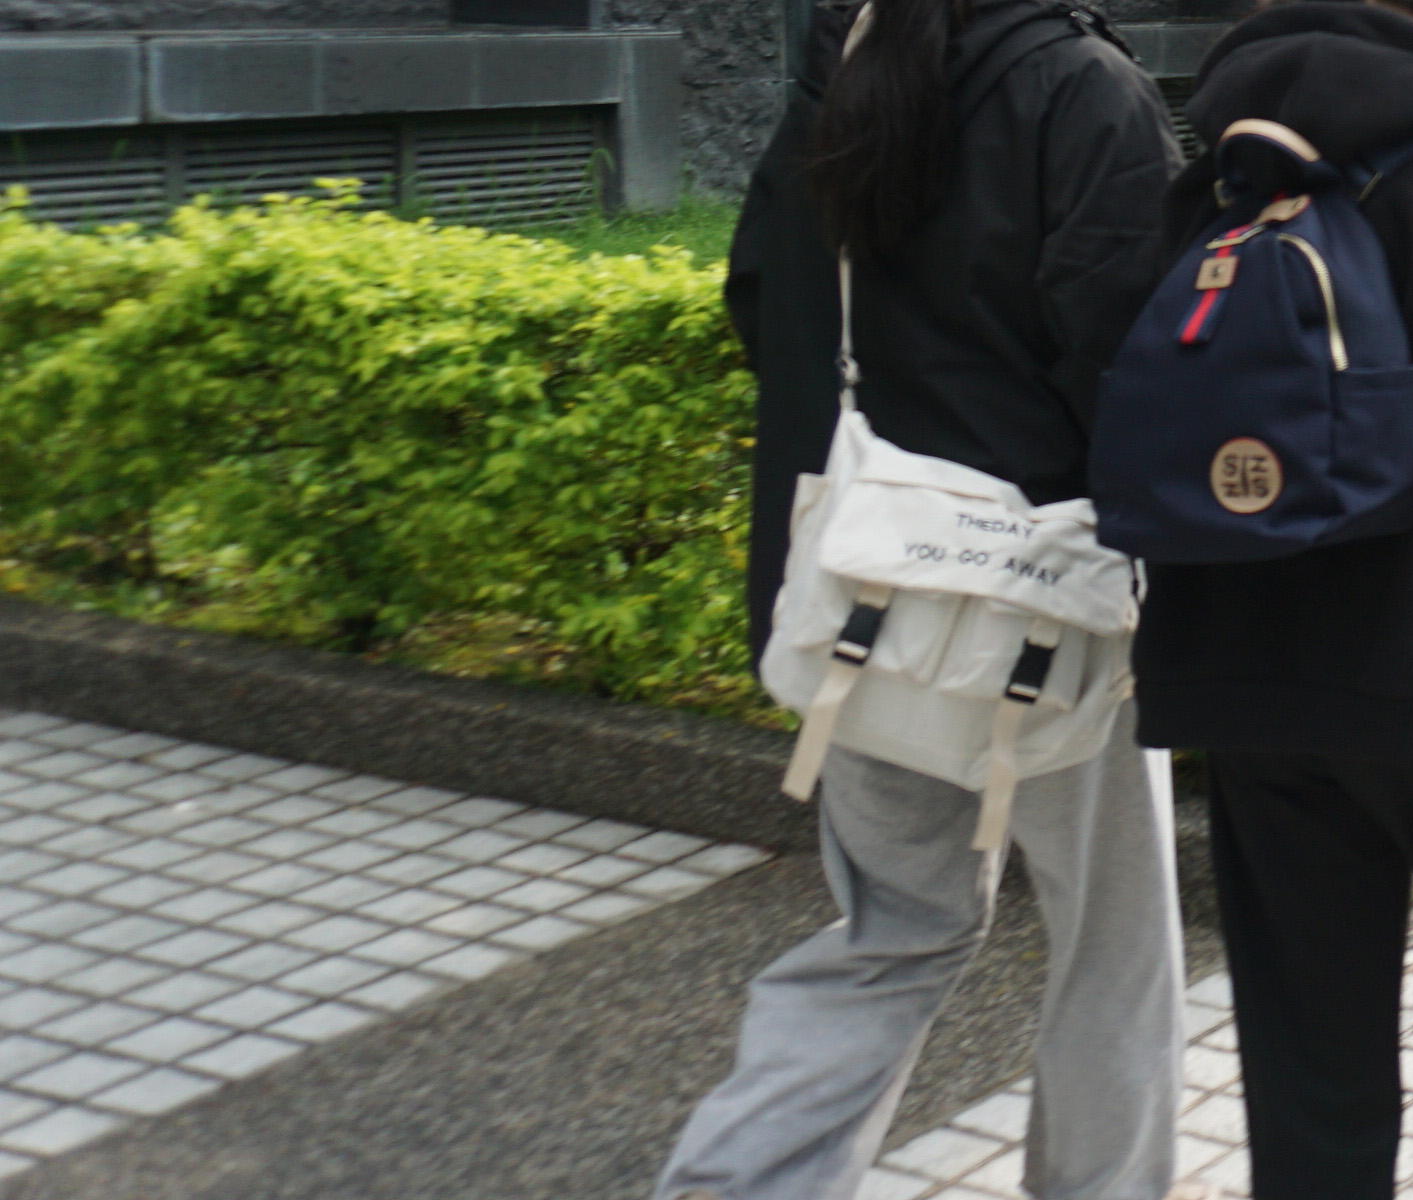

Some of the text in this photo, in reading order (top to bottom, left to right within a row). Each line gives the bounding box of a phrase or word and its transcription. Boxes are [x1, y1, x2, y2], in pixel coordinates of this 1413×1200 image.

[904, 543, 1062, 585] YOU GO AWAY
